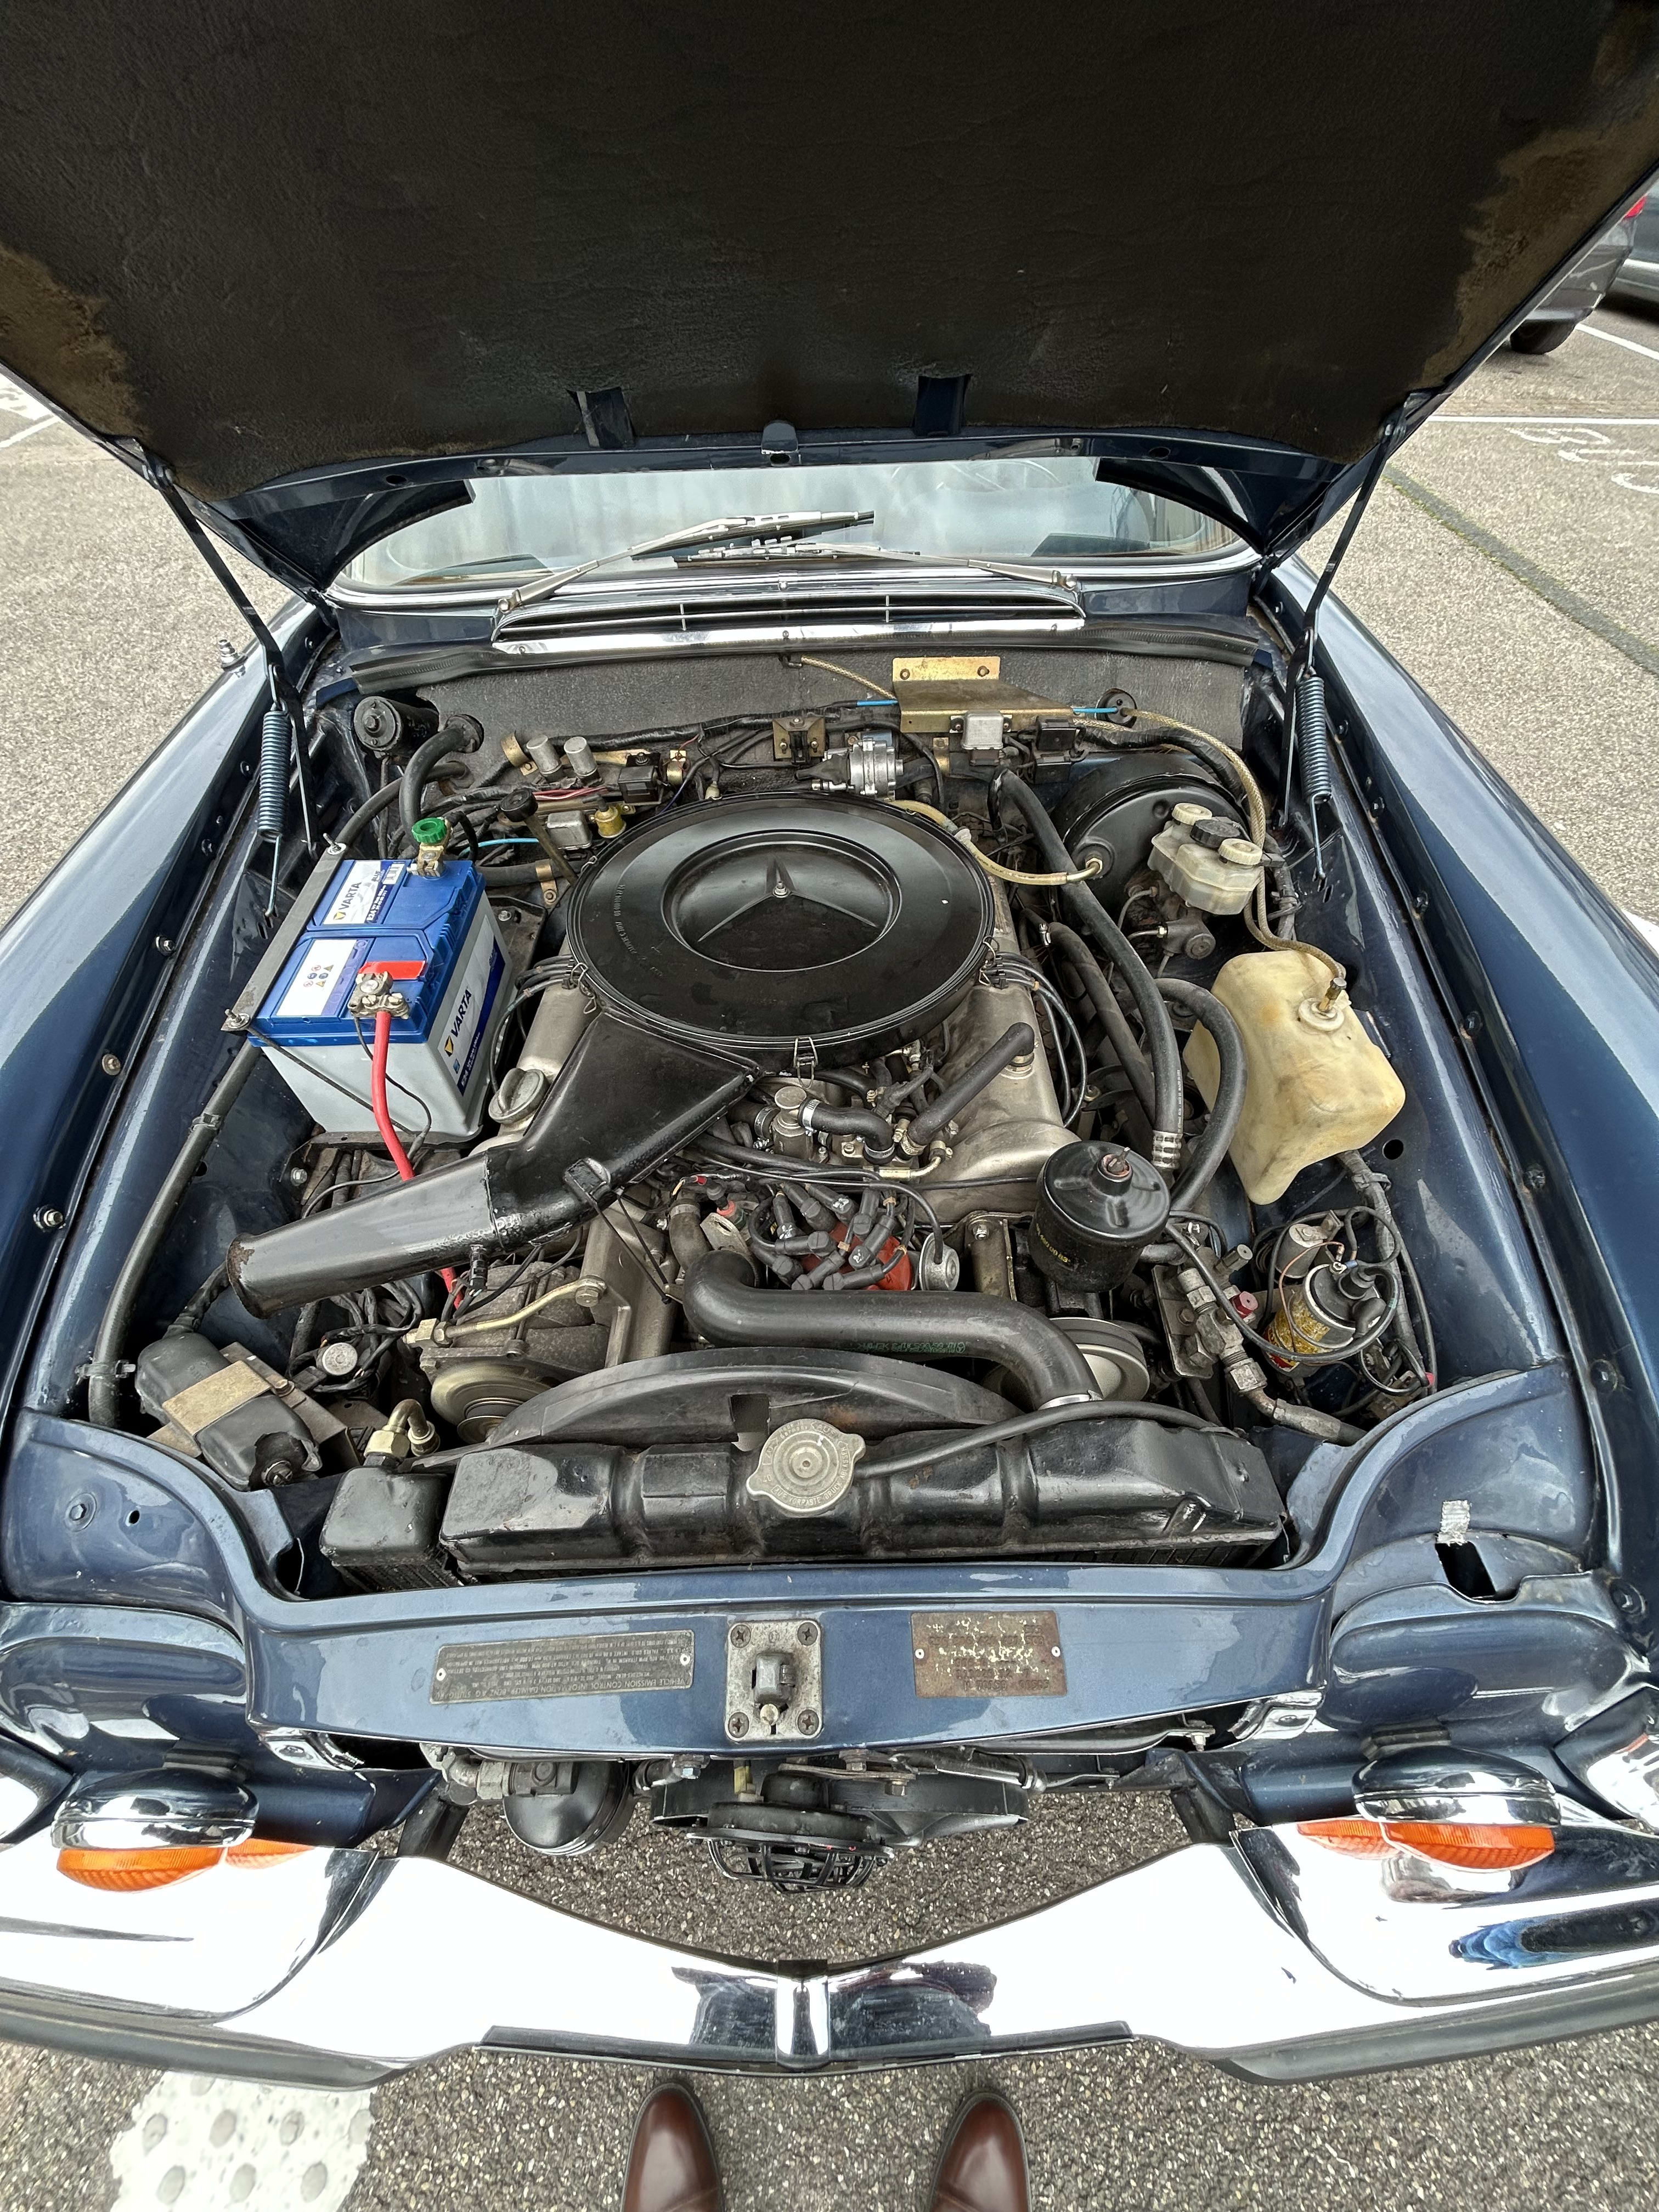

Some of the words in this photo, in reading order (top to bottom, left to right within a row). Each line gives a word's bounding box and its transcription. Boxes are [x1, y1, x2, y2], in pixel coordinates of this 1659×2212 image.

[338, 882, 362, 910] VARTA
[451, 989, 472, 1037] VARTA
[591, 1681, 622, 1689] CONTROL
[624, 1679, 656, 1688] EMISSION
